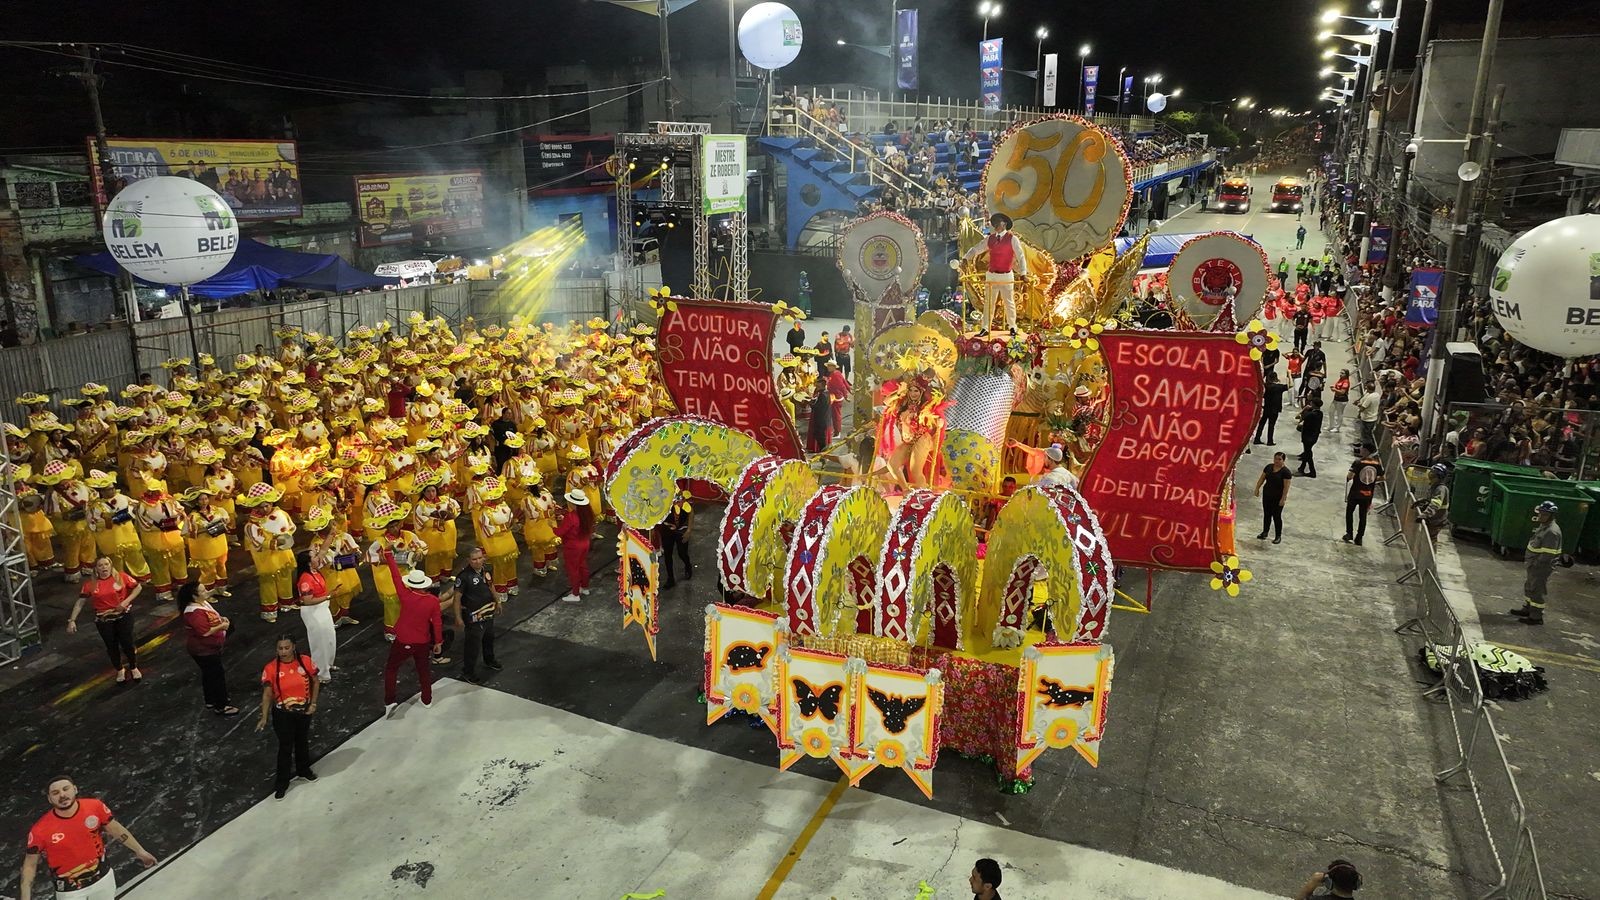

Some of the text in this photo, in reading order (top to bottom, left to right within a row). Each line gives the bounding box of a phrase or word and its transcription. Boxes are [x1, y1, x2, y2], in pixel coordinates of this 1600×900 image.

[170, 148, 217, 158] 6 DE ABRIL
[714, 149, 736, 162] MESTRE
[717, 163, 741, 177] ROBERTO
[993, 129, 1107, 223] 50
[110, 240, 163, 259] BELÉM
[1193, 260, 1241, 287] BATERIA
[667, 309, 763, 342] A CULTURA
[692, 336, 741, 363] NÃO
[1116, 342, 1251, 376] ESCOLA DE
[674, 369, 773, 398] TEM DONO!
[1132, 374, 1240, 417] SAMBA
[733, 398, 750, 425] É
[1139, 411, 1234, 444] NÃO É
[1116, 437, 1229, 472] BAGUNÇA
[1155, 464, 1173, 483] É
[1092, 509, 1216, 549] ULTURAL
